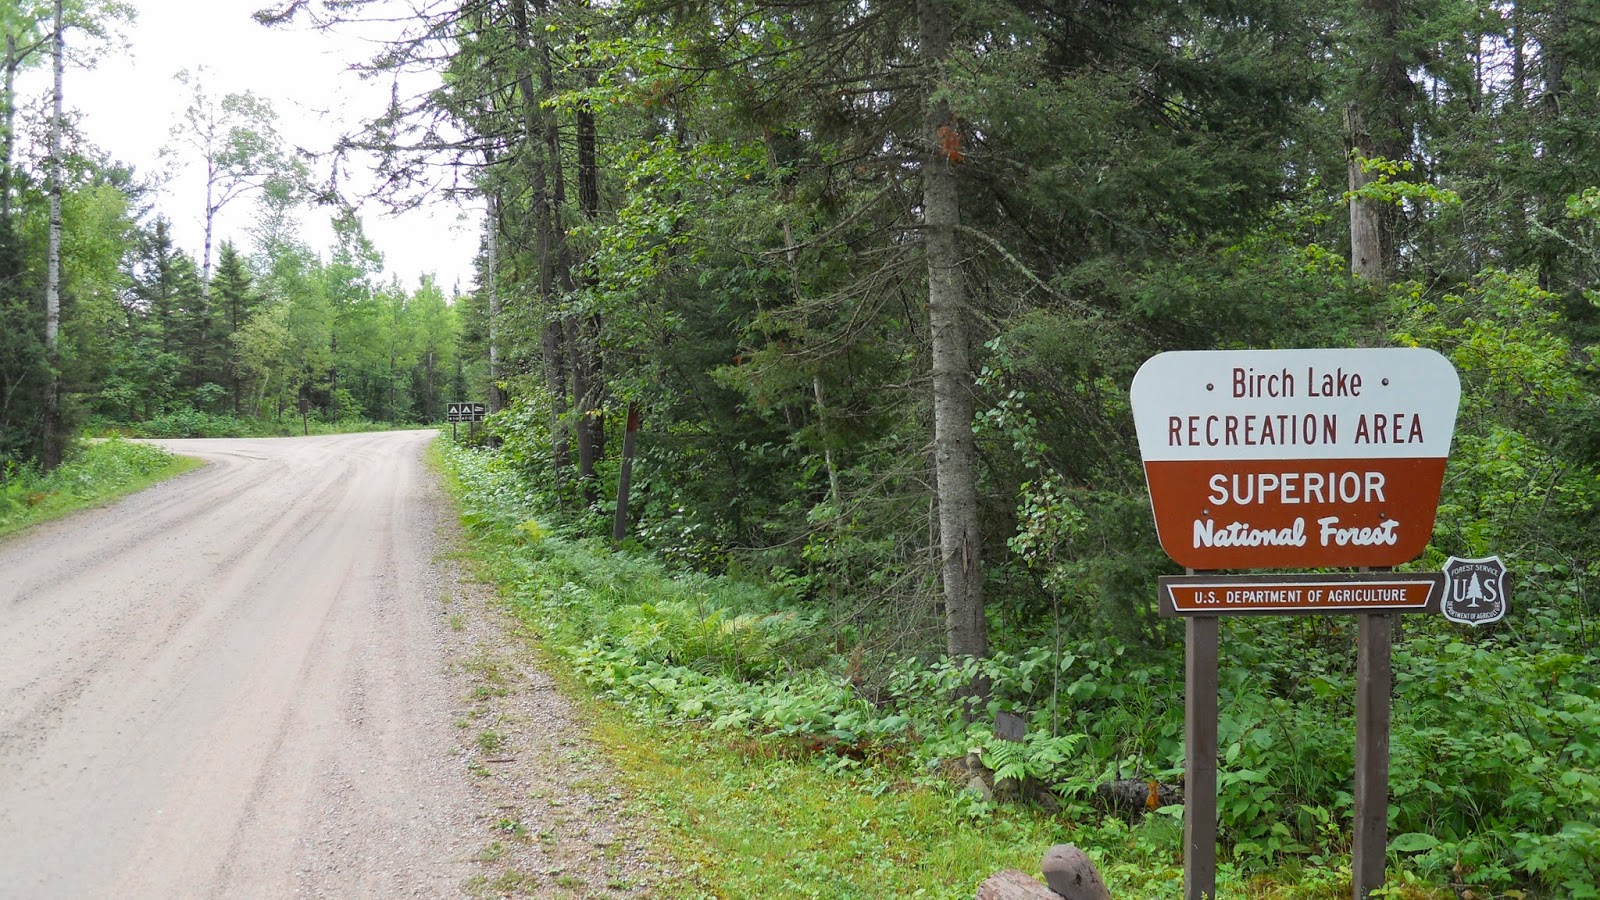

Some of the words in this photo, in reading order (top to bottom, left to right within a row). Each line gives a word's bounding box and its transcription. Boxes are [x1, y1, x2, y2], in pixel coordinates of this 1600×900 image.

[1232, 367, 1294, 398] Birch
[1308, 366, 1362, 397] Lake
[1168, 414, 1337, 446] RECREATION
[1354, 413, 1424, 444] AREA
[1208, 471, 1386, 506] SUPERIOR
[1193, 517, 1307, 549] National
[1318, 516, 1399, 547] Forest
[1452, 565, 1474, 576] FOREST
[1475, 564, 1498, 577] SERVICE
[1194, 591, 1220, 604] U.S.
[1226, 590, 1302, 604] DEPARTMENT
[1307, 590, 1323, 603] OF
[1328, 588, 1407, 602] AGRICULTURE
